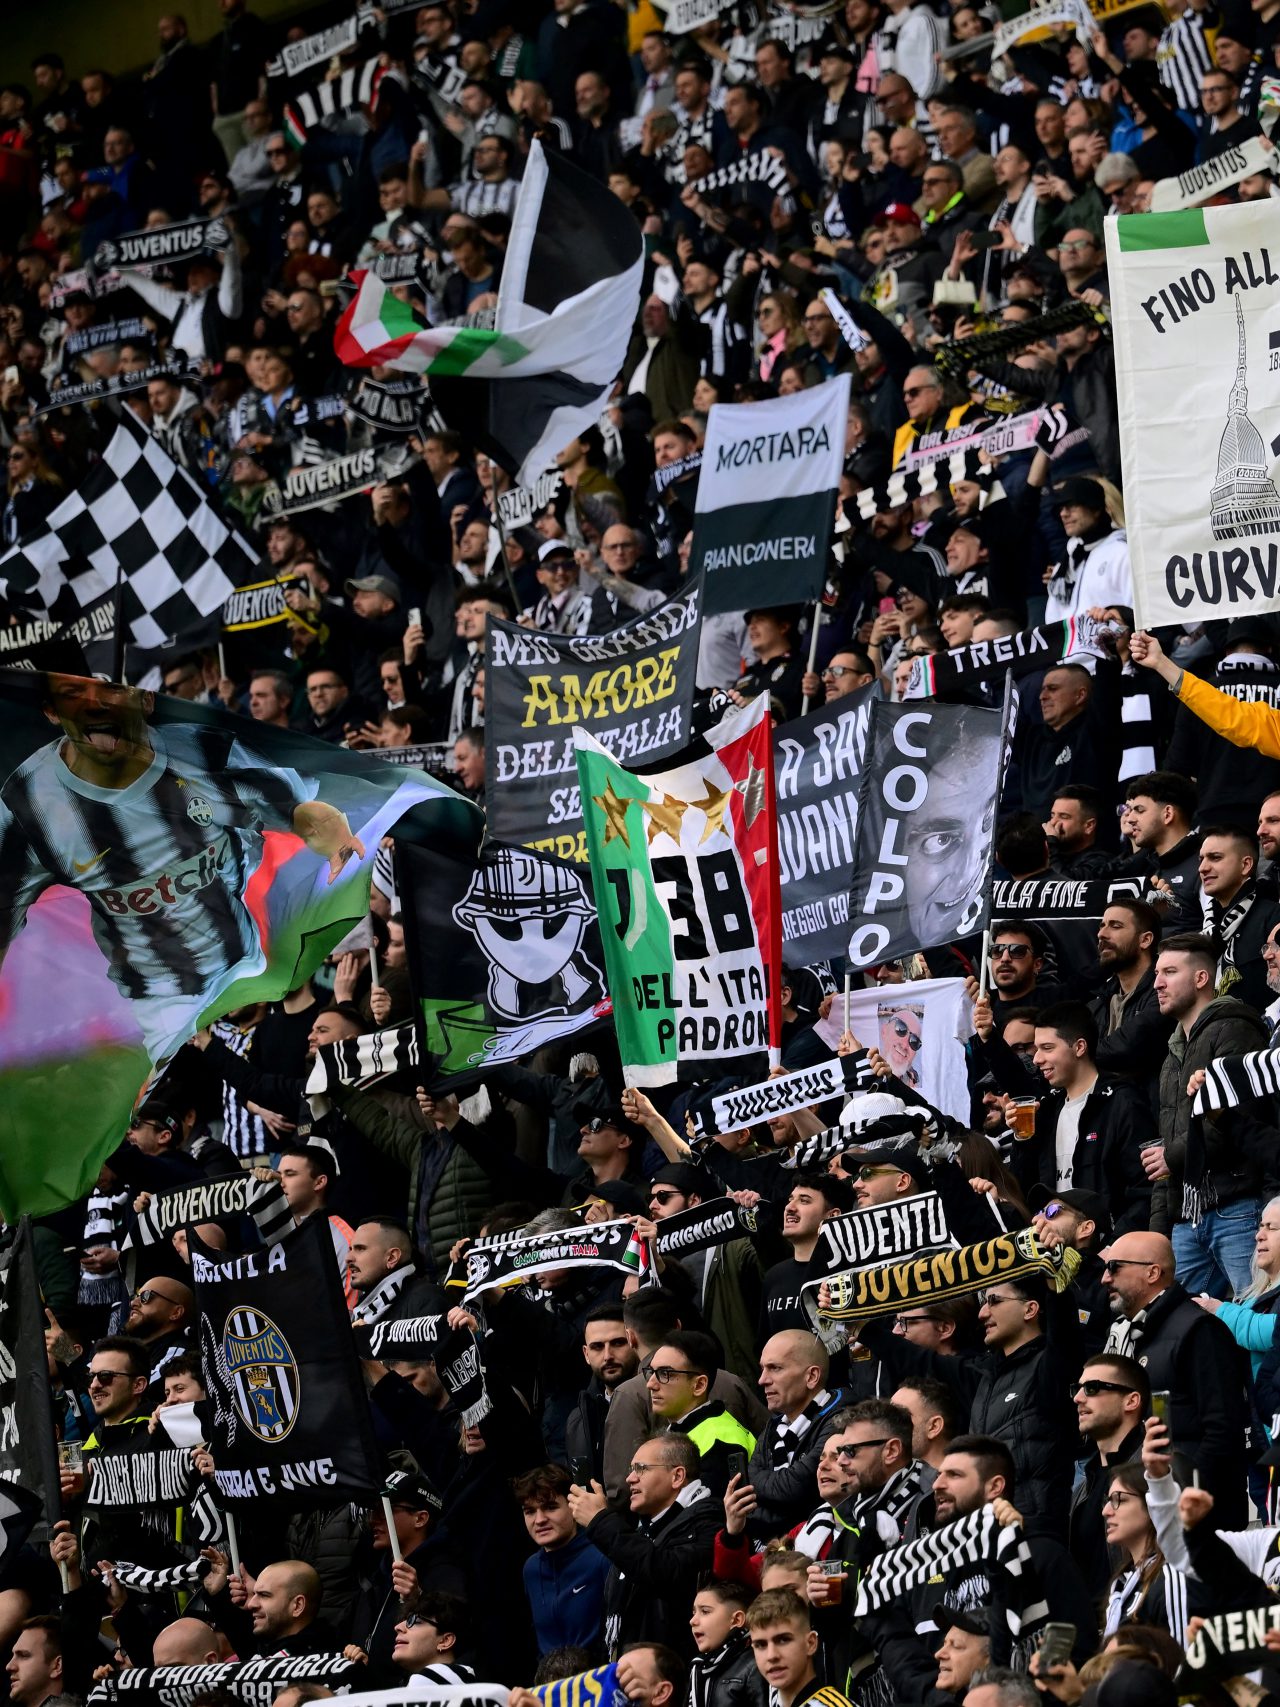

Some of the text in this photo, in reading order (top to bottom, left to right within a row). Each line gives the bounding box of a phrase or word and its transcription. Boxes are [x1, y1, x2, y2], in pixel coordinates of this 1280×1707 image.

[1178, 146, 1248, 199] JUVENTUS
[120, 225, 205, 262] JUVENTUS
[1141, 266, 1215, 333] FINO
[282, 448, 376, 500] JUVENTUS
[715, 424, 830, 472] MORTARA
[568, 589, 700, 663] GRANDE
[948, 627, 1050, 674] TREIA
[521, 645, 682, 728] AMORE
[101, 836, 231, 916] Betclic
[1039, 879, 1088, 908] FINE
[651, 849, 755, 961] 38
[722, 1067, 834, 1128] JUVENTUS
[160, 1178, 246, 1231] JUVENTUS
[268, 1242, 287, 1274] A
[826, 1197, 949, 1269] JUVENTU
[857, 1235, 1017, 1305] JUVENTUS
[387, 1314, 442, 1343] JUVENTUS
[767, 1294, 802, 1314] HILFI
[227, 1330, 285, 1367] JUVENTUS
[441, 1343, 482, 1393] 1897
[88, 1458, 129, 1505] BLACK
[159, 1448, 192, 1501] WHIT
[256, 1466, 276, 1495] E
[280, 1457, 337, 1491] JUVE
[117, 1651, 356, 1691] DI PADRE IN FIGLIO
